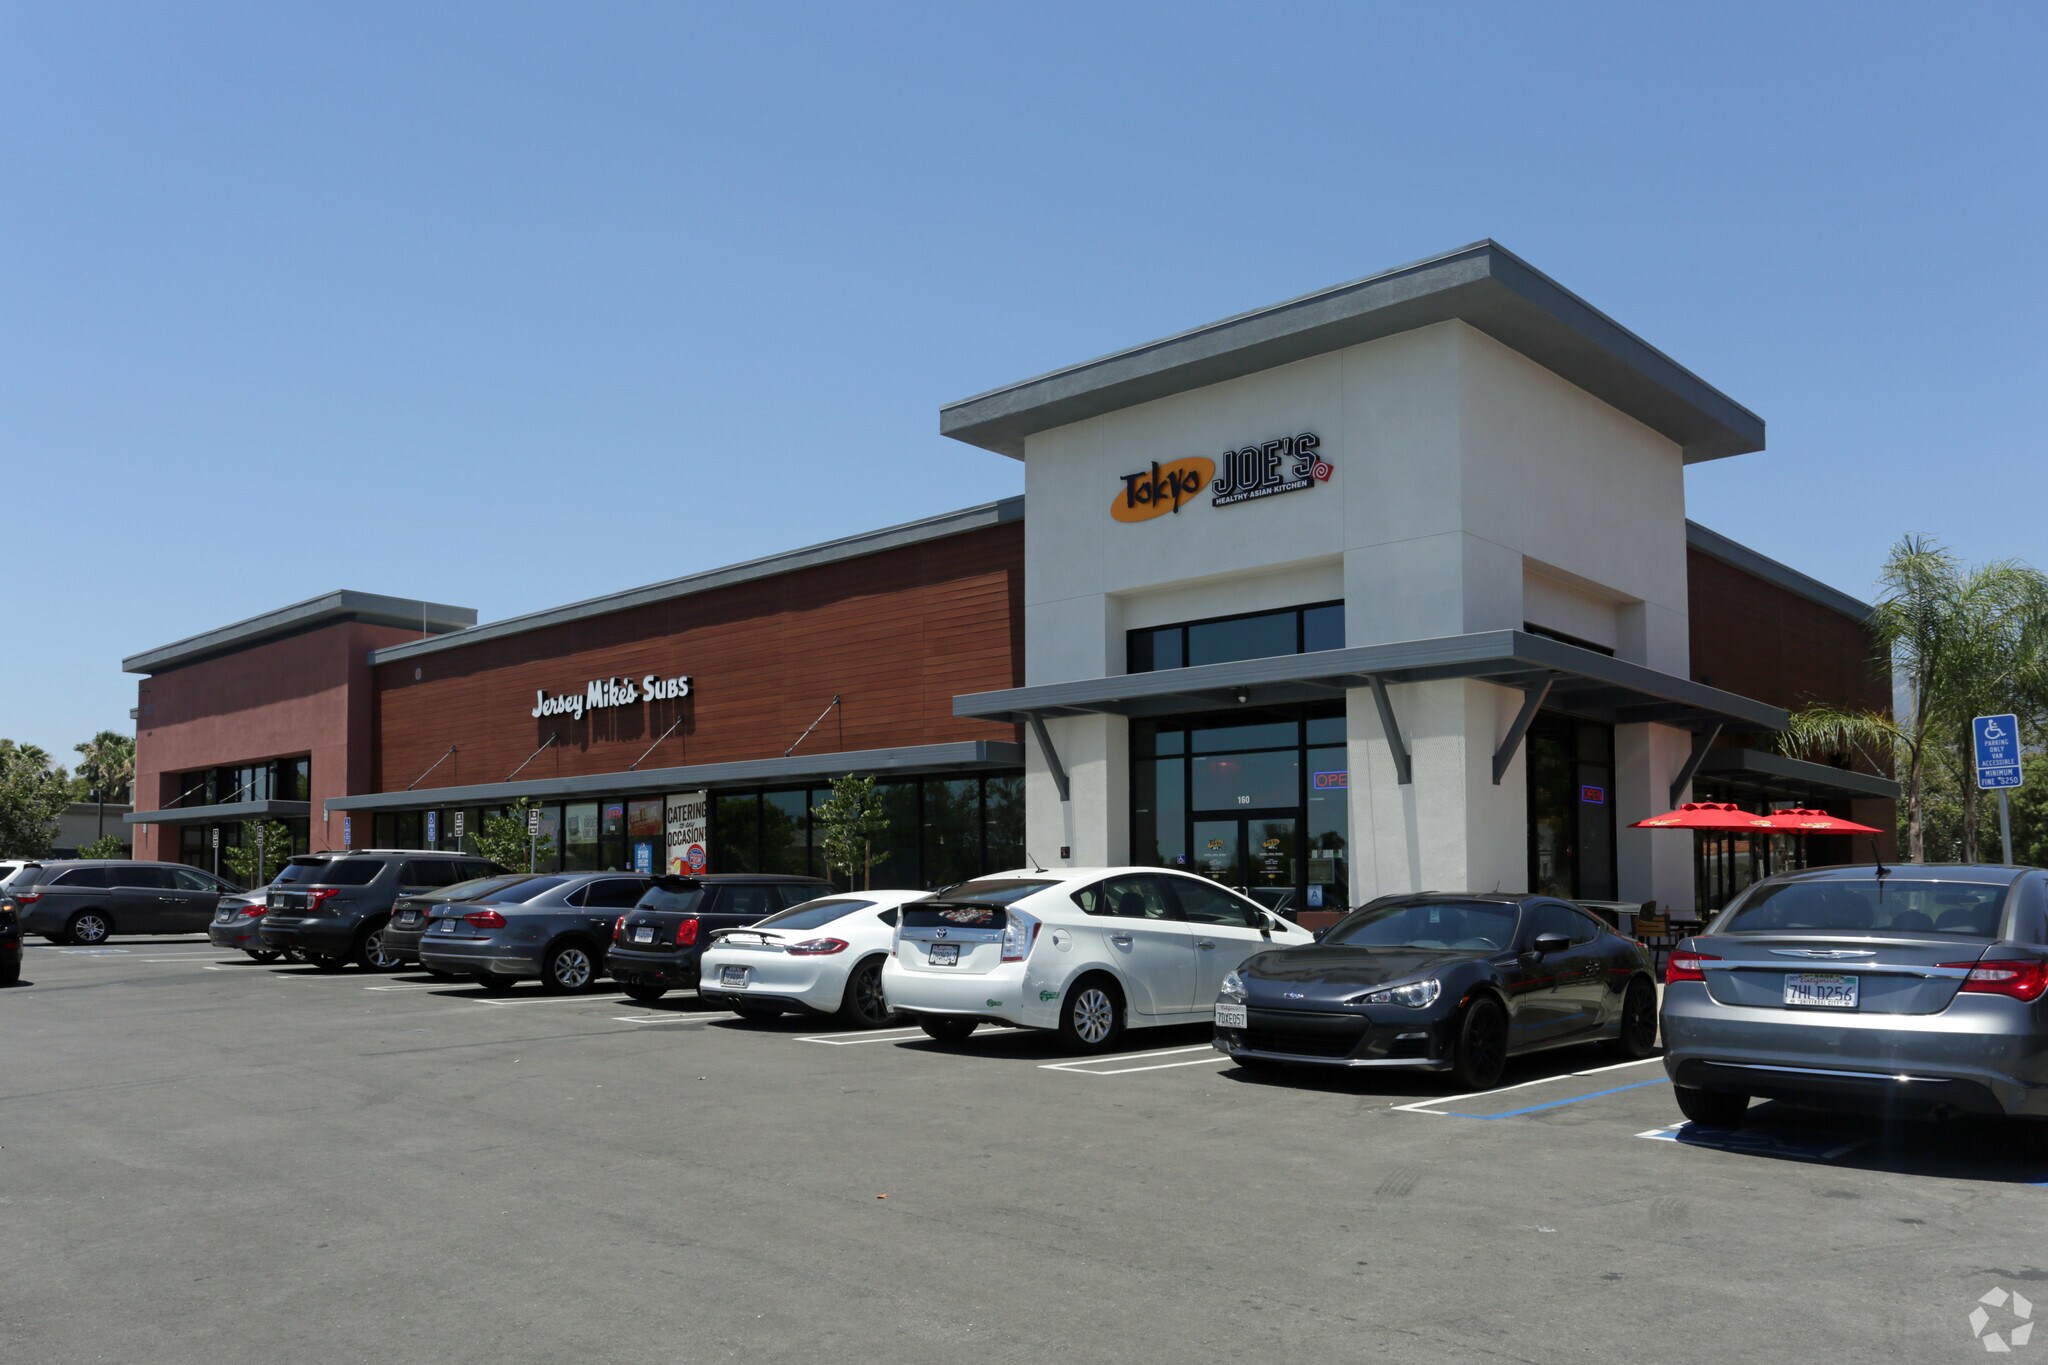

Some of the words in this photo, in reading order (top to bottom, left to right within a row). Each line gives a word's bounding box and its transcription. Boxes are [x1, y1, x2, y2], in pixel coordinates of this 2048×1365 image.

[1120, 461, 1200, 513] Tokyo
[1212, 432, 1319, 496] JOE'S
[1216, 492, 1248, 505] HEALTHY
[1250, 487, 1272, 498] ASIAN
[1273, 480, 1307, 492] KITCHEN
[532, 690, 584, 720] Jersey
[586, 677, 639, 710] Mike's
[1985, 769, 2013, 777] MINIMUM
[1316, 774, 1348, 787] OPE
[1981, 778, 1996, 786] FINE
[1237, 795, 1250, 804] 160
[1583, 788, 1602, 801] OPEN
[668, 801, 706, 824] CATERING
[1311, 890, 1319, 899] A
